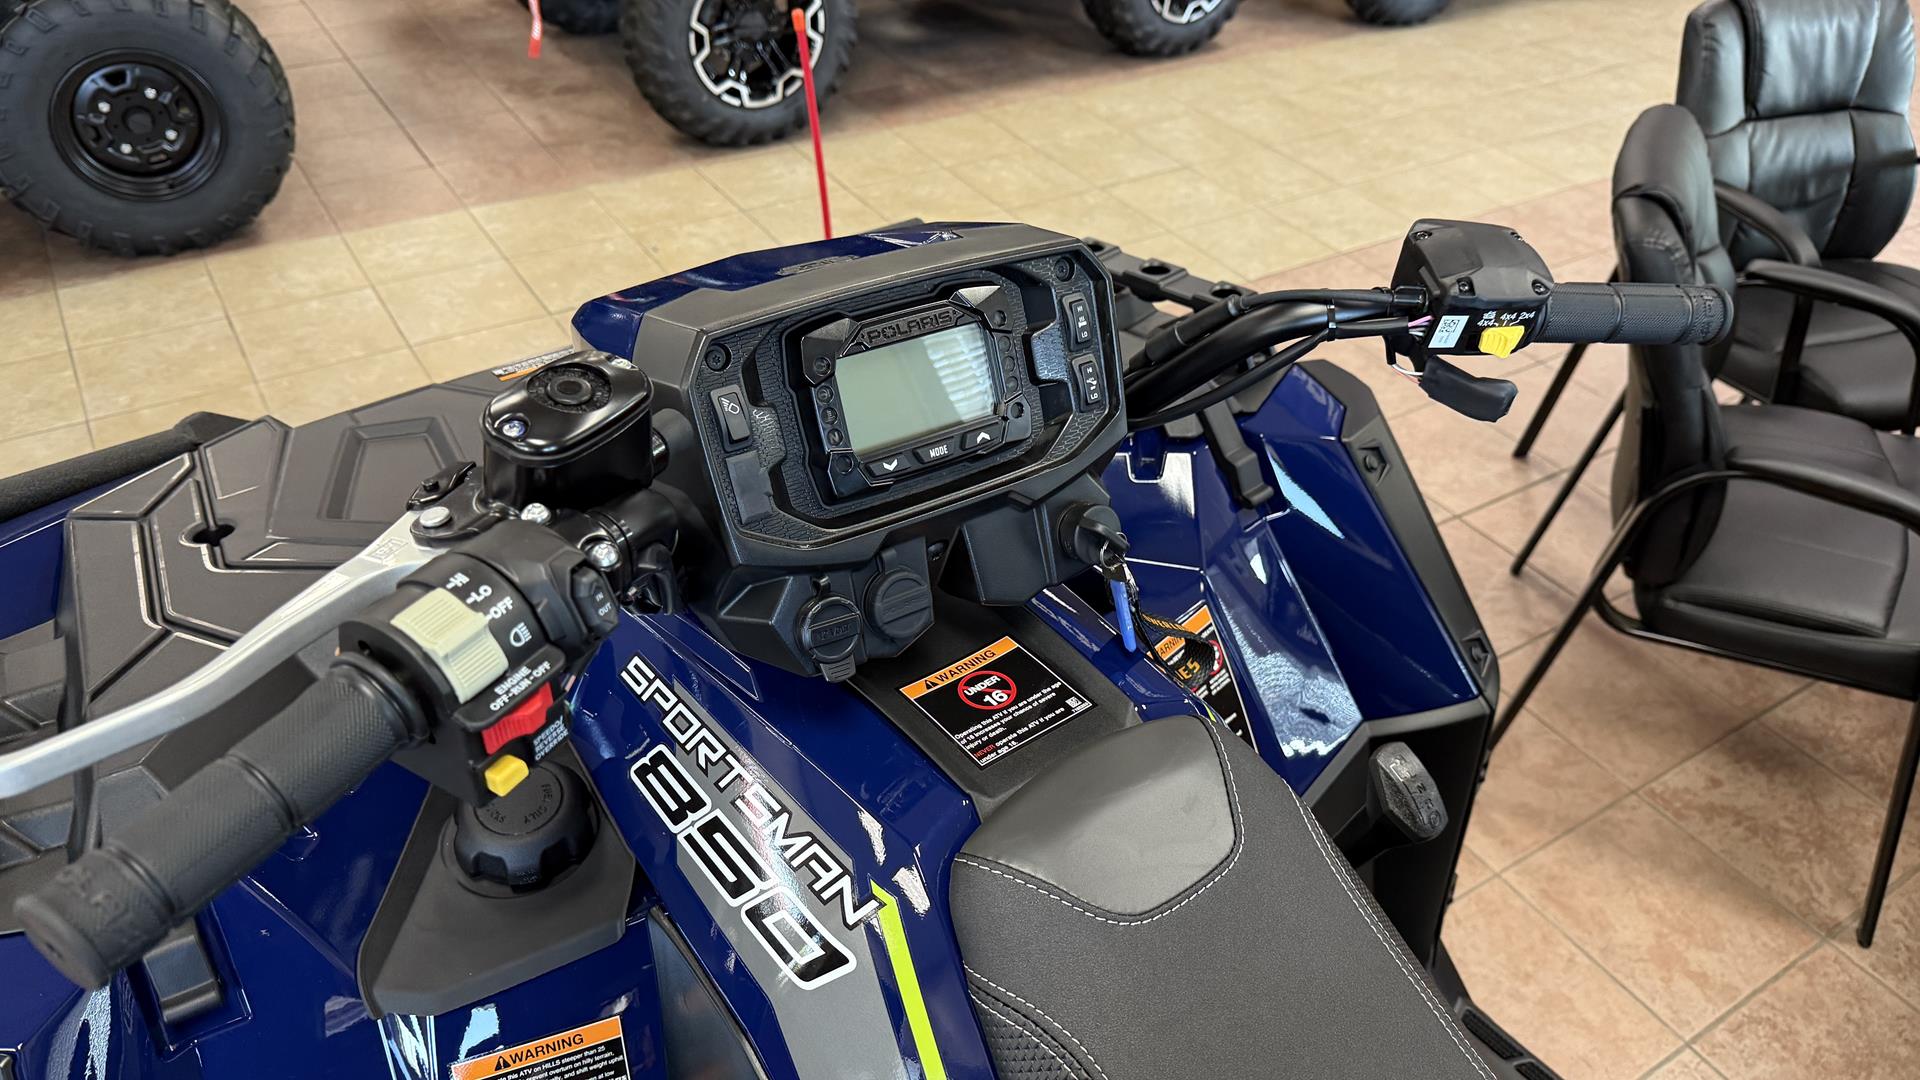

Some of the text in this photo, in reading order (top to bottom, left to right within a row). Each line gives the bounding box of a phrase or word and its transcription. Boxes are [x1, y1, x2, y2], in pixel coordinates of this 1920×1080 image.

[1477, 319, 1495, 327] 4x4
[1500, 312, 1518, 321] 4x4
[1519, 310, 1537, 320] 2x4
[867, 310, 953, 344] POLARIS
[929, 444, 948, 459] MODE
[470, 584, 493, 602] LO
[595, 591, 604, 602] IN
[488, 596, 513, 619] OFF
[598, 602, 612, 616] OUT
[935, 651, 996, 682] WARNING
[494, 666, 532, 696] ENGINE
[964, 675, 1001, 696] UNDER
[983, 690, 1008, 706] 16
[955, 724, 983, 739] Operating
[992, 712, 1003, 720] ATV
[1007, 705, 1019, 713] you
[1027, 692, 1042, 702] under
[973, 722, 1001, 737] increases
[1000, 715, 1013, 724] your
[1013, 705, 1033, 717] chance
[1038, 693, 1056, 704] severe
[534, 724, 567, 753] REVERSE
[965, 739, 982, 750] injury
[989, 727, 1007, 738] death.
[974, 745, 995, 757] NEVER
[995, 733, 1018, 747] operate
[1016, 727, 1029, 735] this
[1028, 720, 1039, 729] ATV
[1044, 712, 1056, 721] you
[980, 752, 996, 763] under
[997, 745, 1009, 753] age
[618, 654, 887, 929] SPORTSMAN
[630, 744, 857, 991] 850
[509, 1033, 584, 1064] WARNING
[519, 1068, 533, 1077] ATV
[542, 1059, 561, 1070] HILLS
[561, 1053, 583, 1065] steeper
[583, 1048, 597, 1057] than
[597, 1045, 606, 1053] 25
[548, 1064, 573, 1076] overturn
[582, 1057, 594, 1066] hilly
[594, 1051, 615, 1062] terrain,
[563, 1070, 576, 1079] and
[576, 1066, 589, 1075] shift
[589, 1060, 608, 1071] weight
